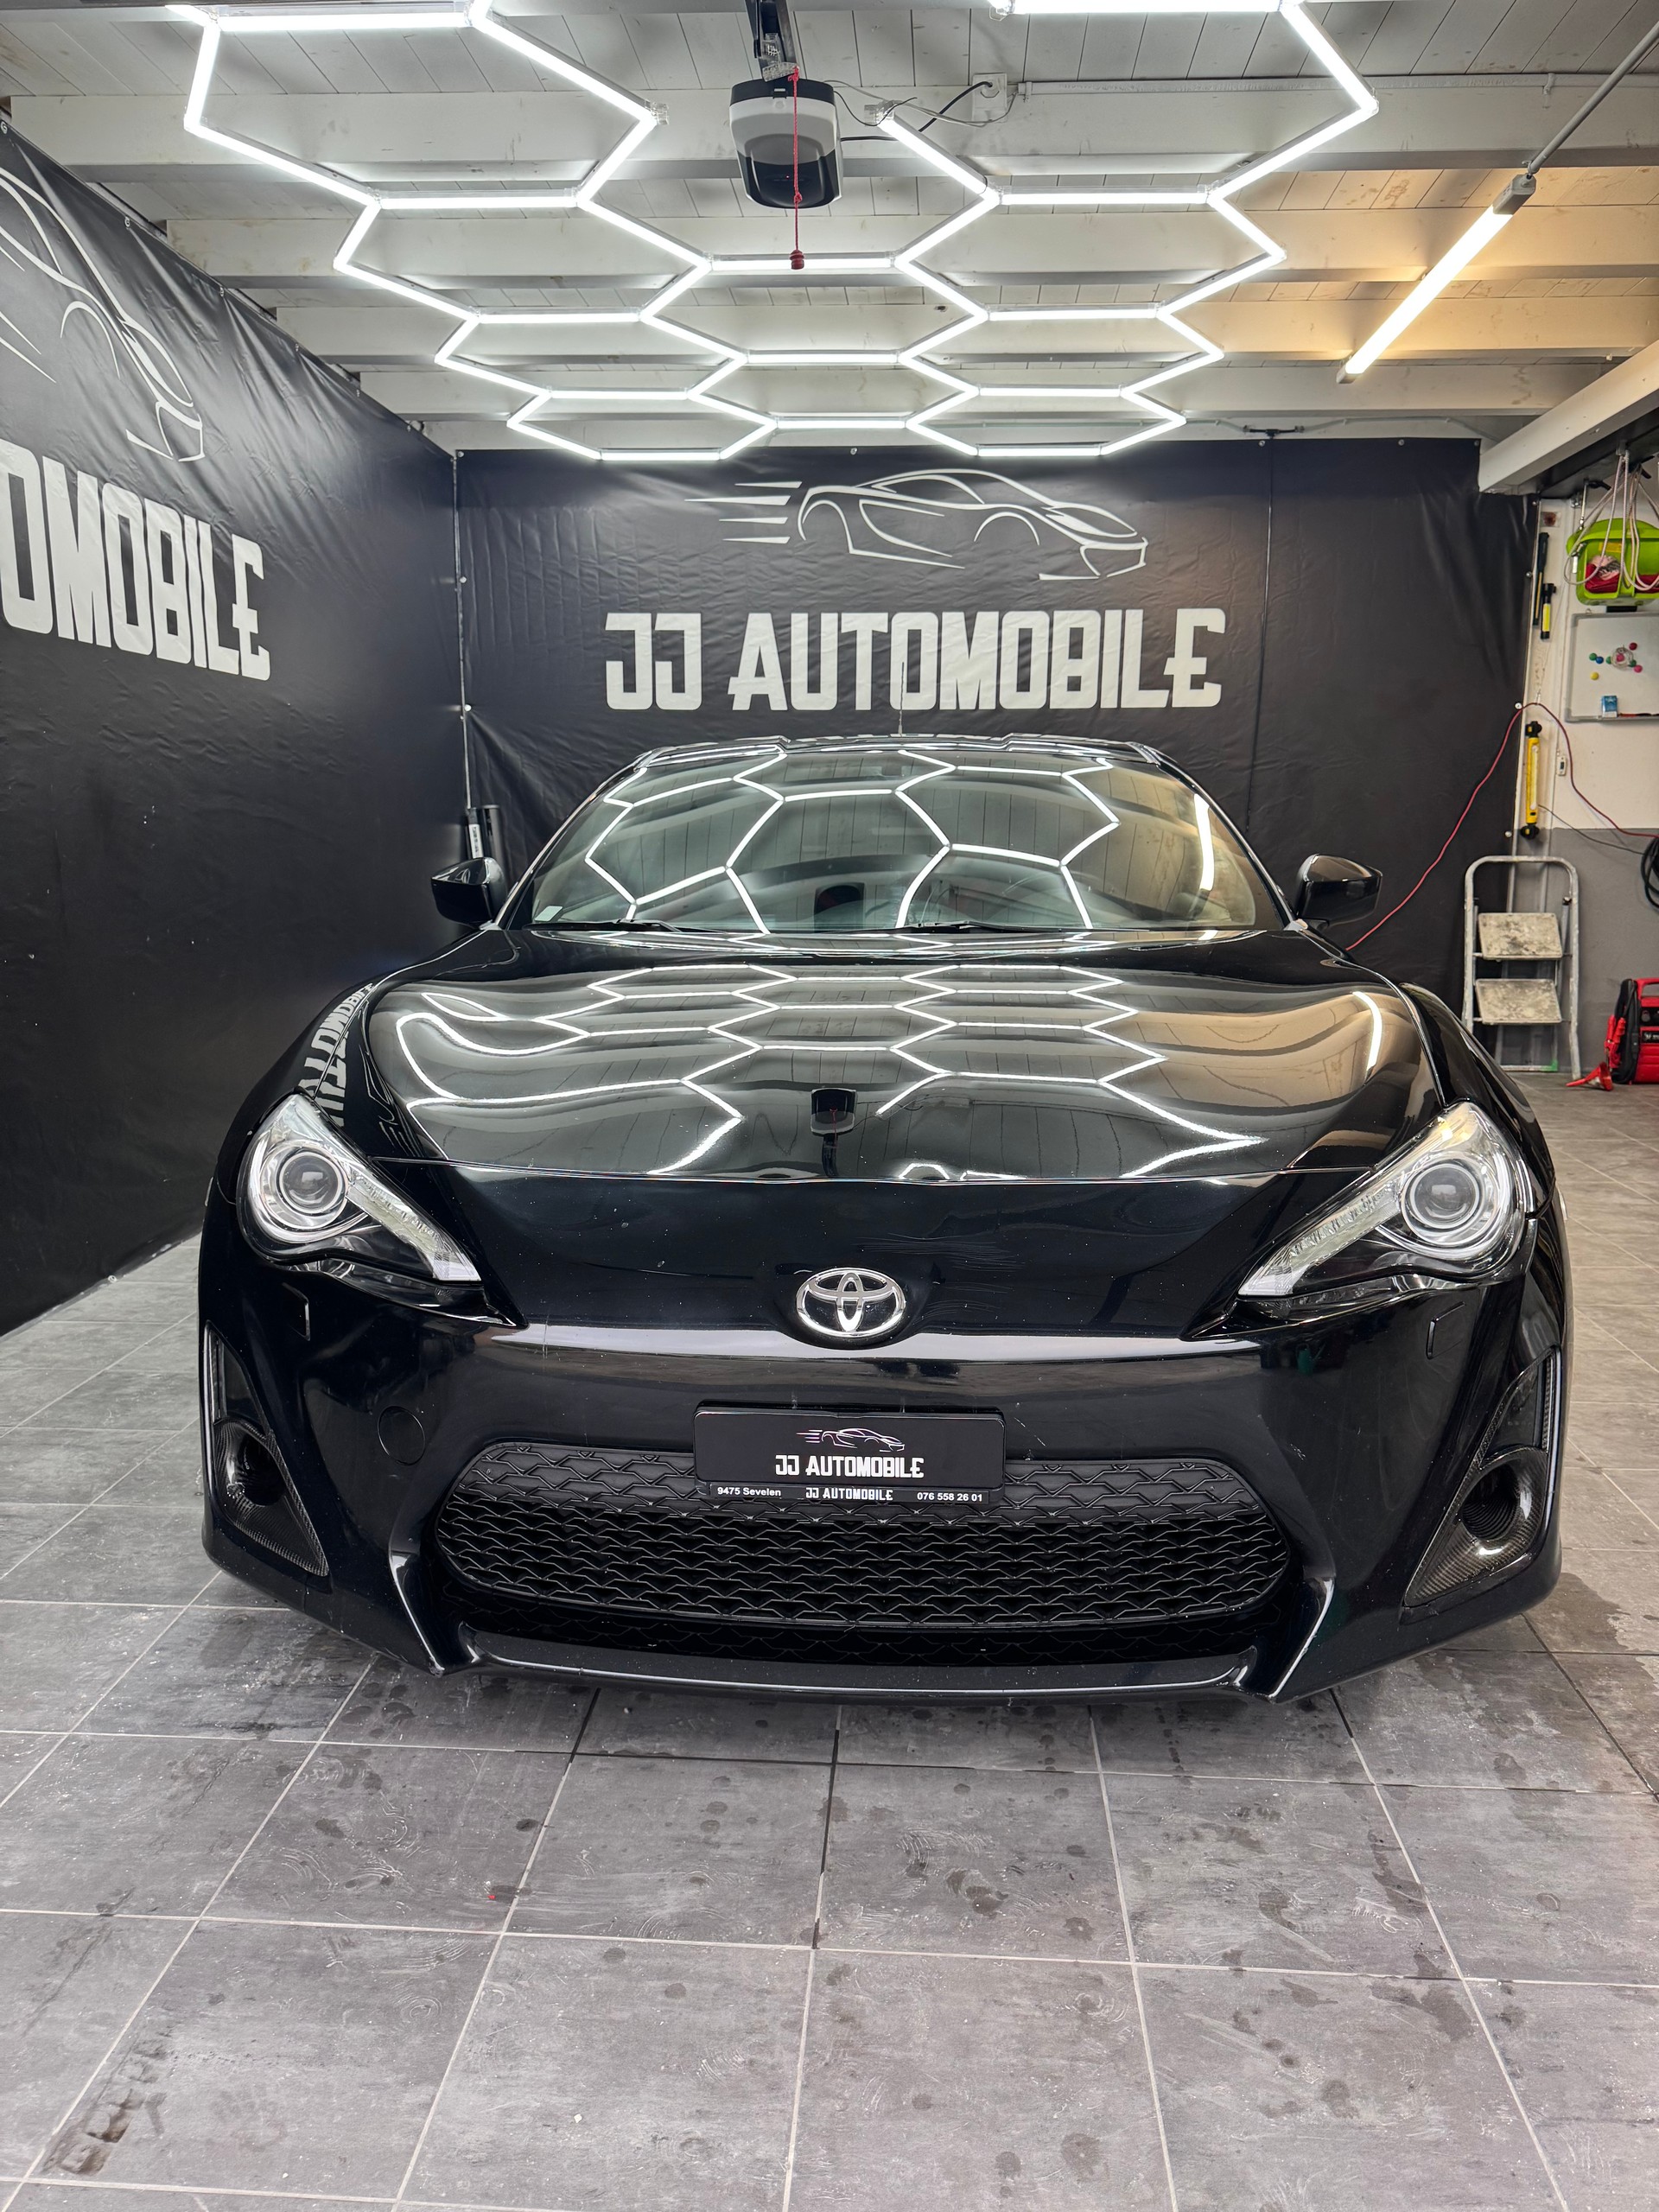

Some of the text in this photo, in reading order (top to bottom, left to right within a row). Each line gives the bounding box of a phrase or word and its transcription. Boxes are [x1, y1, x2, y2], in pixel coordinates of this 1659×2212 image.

[605, 608, 1225, 711] JJ AUTOMOBILE
[775, 1454, 925, 1478] JJ AUTOMOBILE
[717, 1487, 982, 1502] 9475 Sevelen JJ AUTOMOBILE 076 558 26 01
